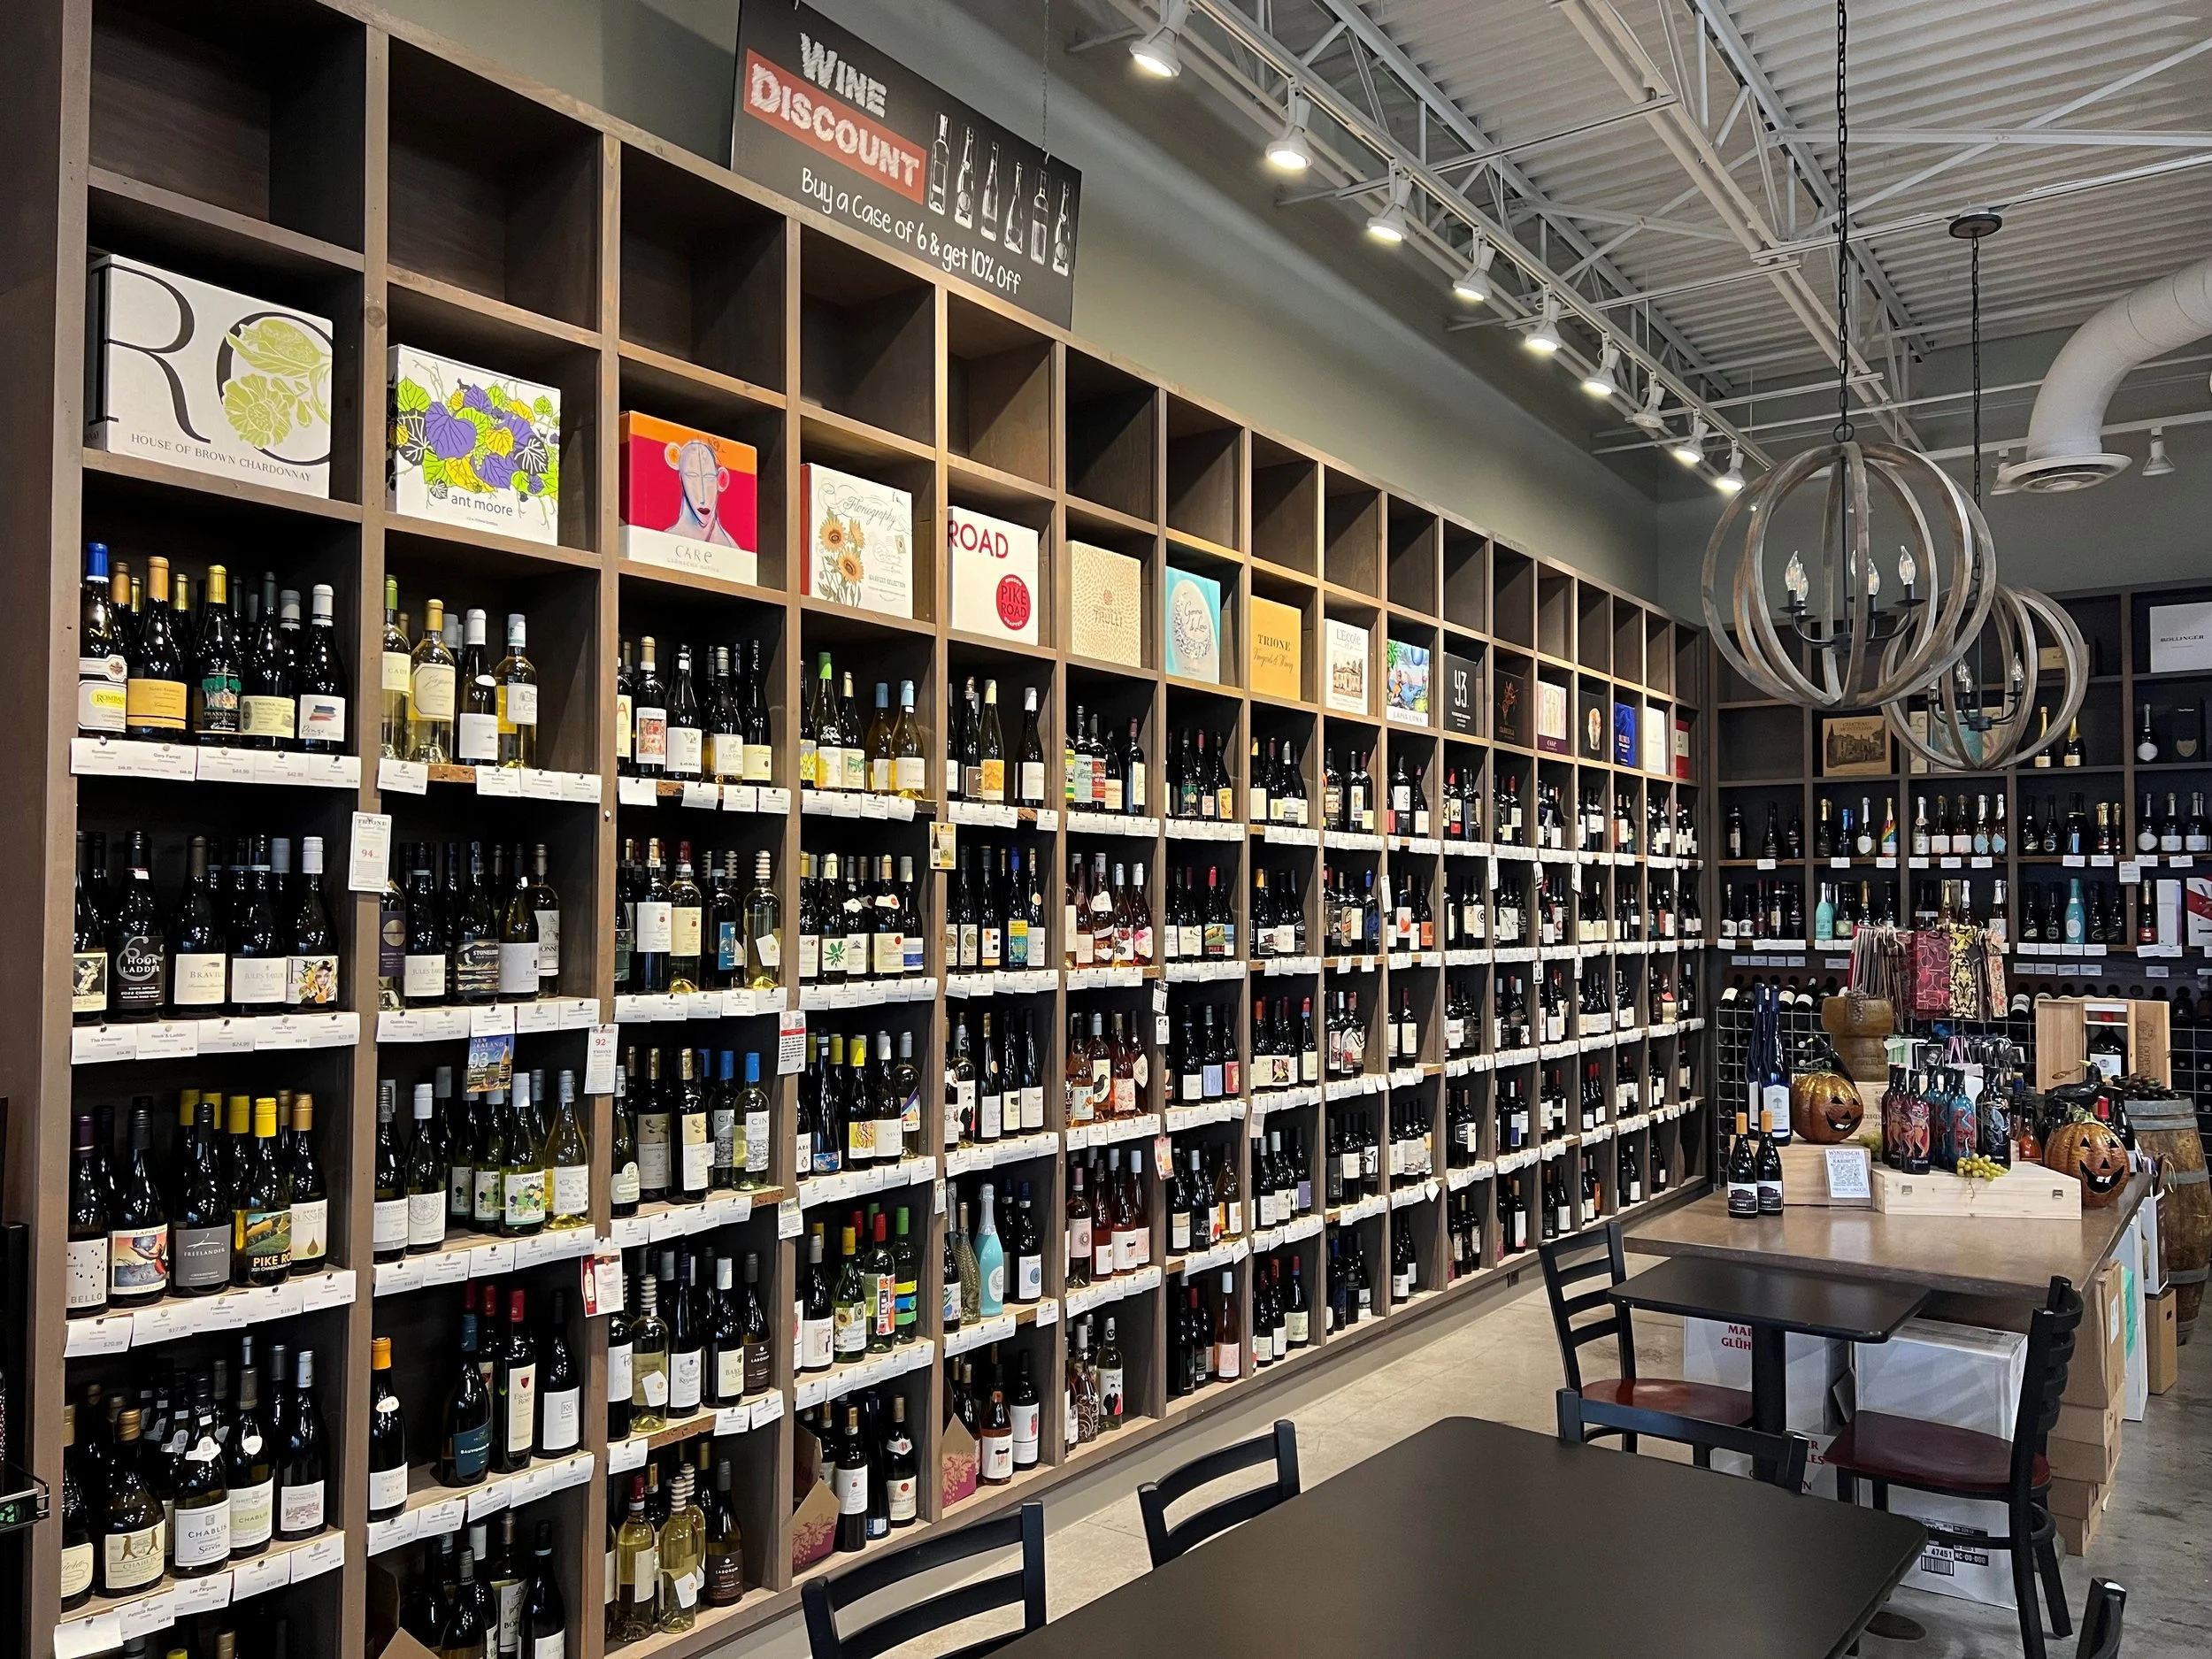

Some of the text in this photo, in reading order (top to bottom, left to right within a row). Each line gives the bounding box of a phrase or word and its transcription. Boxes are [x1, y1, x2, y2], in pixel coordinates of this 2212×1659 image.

[800, 32, 887, 118] WINE
[750, 63, 919, 187] DISCOUNT
[802, 167, 1022, 294] Buy a Case of 6 & get 10% Off
[131, 433, 311, 483] HOUSE OF BROWN CHARDONNAY
[450, 495, 513, 517] ant moore
[948, 519, 1009, 559] ROAD
[1001, 586, 1027, 606] PIKE
[1001, 603, 1027, 618] ROAD
[1257, 634, 1291, 652] TRIONE
[1393, 710, 1409, 722] LAPIS
[361, 849, 374, 858] 94
[123, 965, 160, 974] LADDER
[183, 1248, 226, 1257] FREELANDER
[253, 1256, 278, 1267] PIKE
[71, 1293, 103, 1304] BELLO
[238, 1511, 269, 1525] CHABLIS
[188, 1524, 227, 1540] CHABLIS
[1931, 1548, 1952, 1559] 47451
